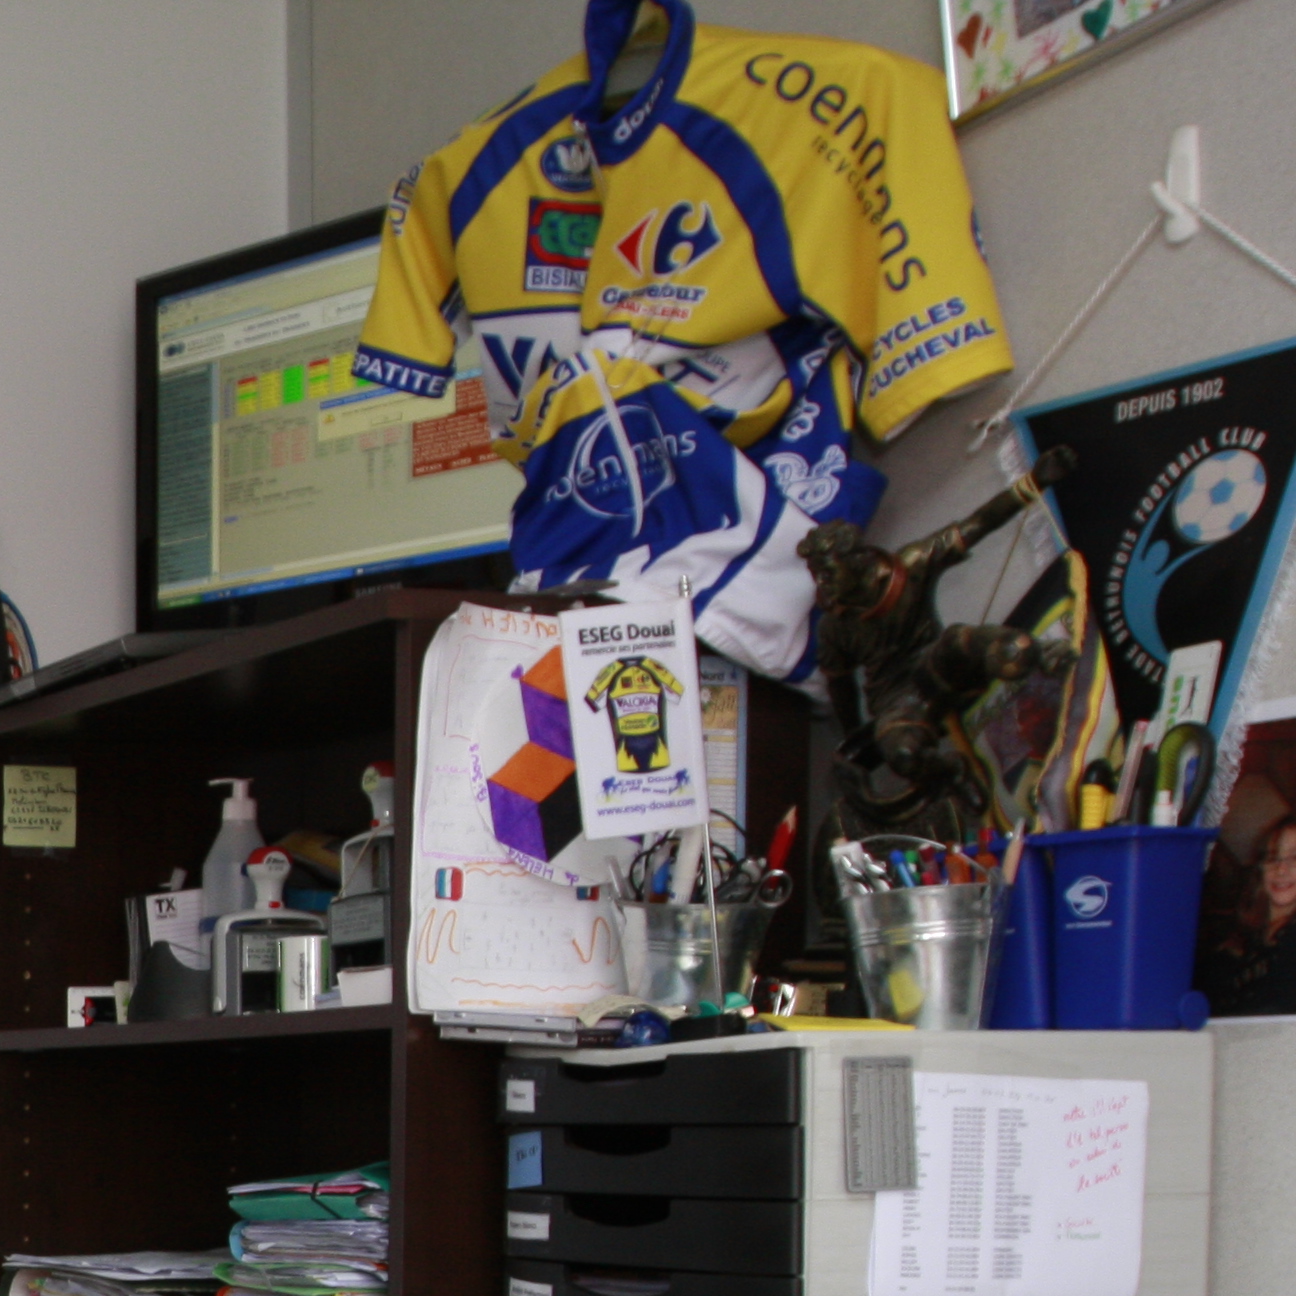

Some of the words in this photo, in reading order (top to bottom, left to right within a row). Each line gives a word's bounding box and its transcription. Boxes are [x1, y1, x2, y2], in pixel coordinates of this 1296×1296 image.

[745, 53, 926, 291] coenmans
[872, 297, 967, 361] CYCLES
[1116, 389, 1177, 423] DEPUIS
[1181, 376, 1225, 407] 1902
[1217, 426, 1268, 452] CLUB
[1135, 437, 1212, 523] FOOTBALL
[578, 625, 623, 645] ESEG
[627, 619, 676, 640] Douai
[1124, 643, 1166, 683] TADE
[155, 897, 176, 914] TX
